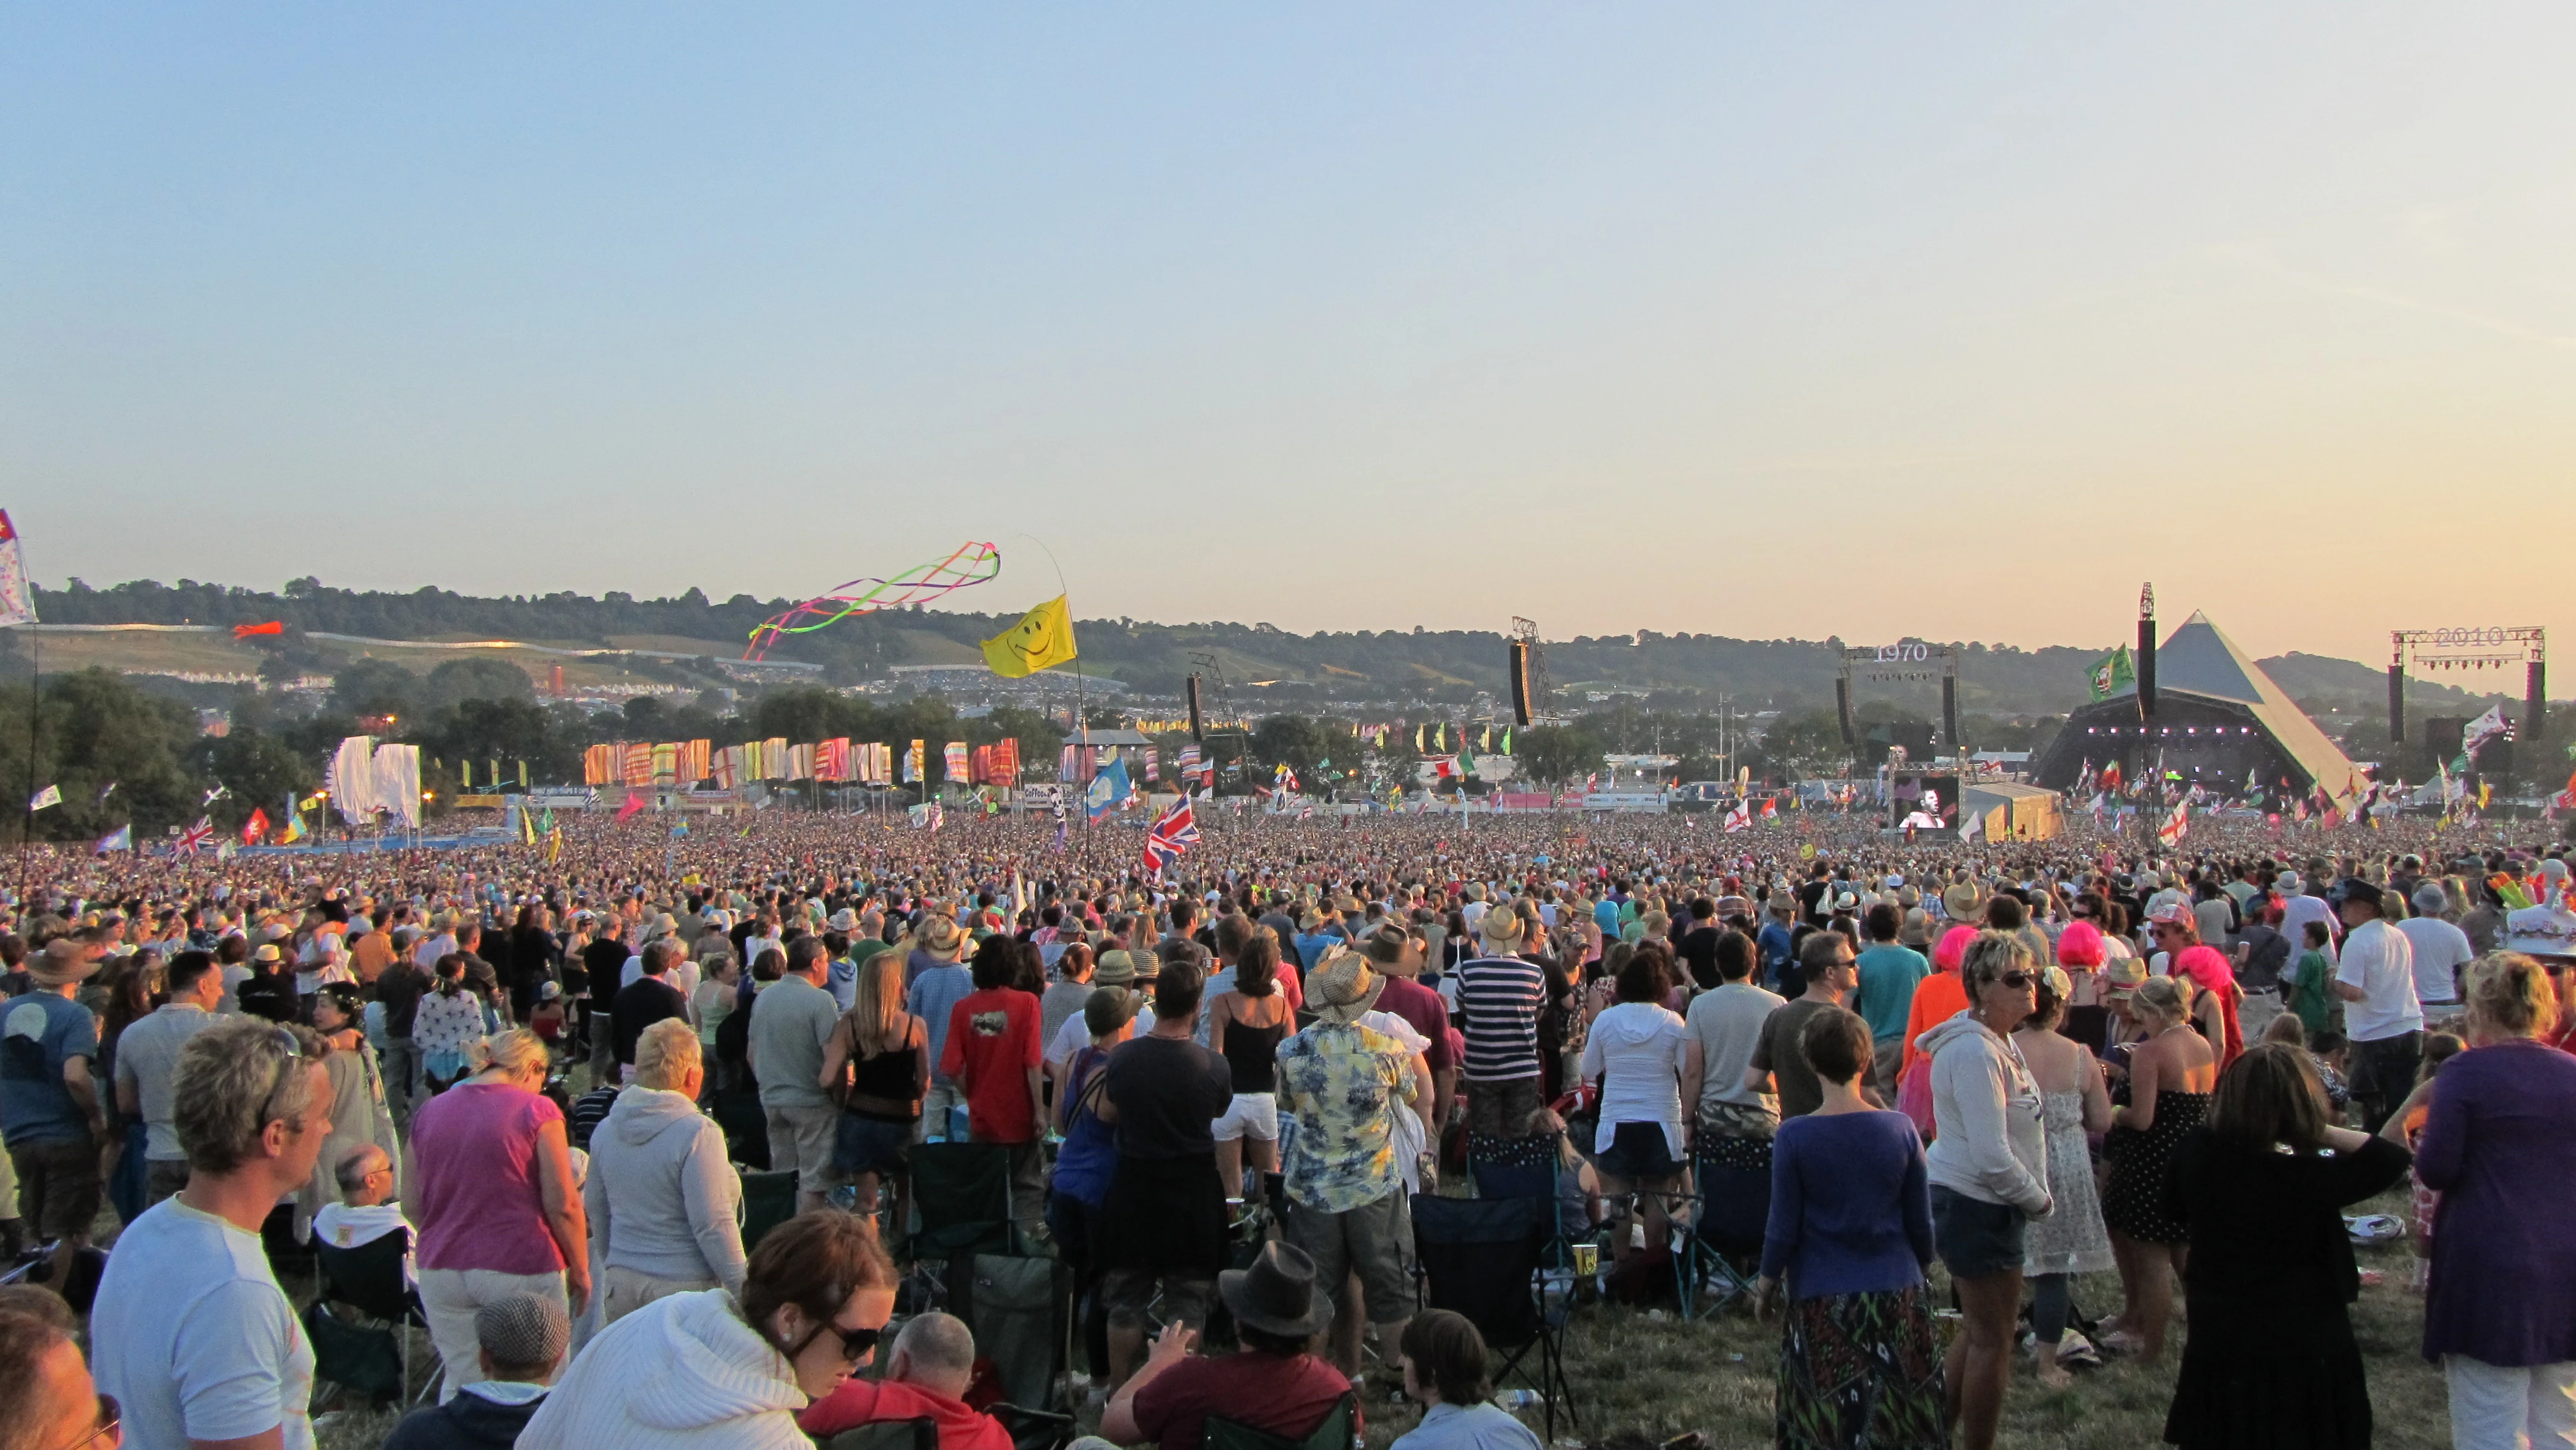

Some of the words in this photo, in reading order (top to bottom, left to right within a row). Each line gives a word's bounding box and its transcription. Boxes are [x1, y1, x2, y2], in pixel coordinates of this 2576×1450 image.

[2436, 627, 2504, 647] 2010
[1874, 644, 1927, 662] 1970
[1025, 788, 1044, 797] Coffee
